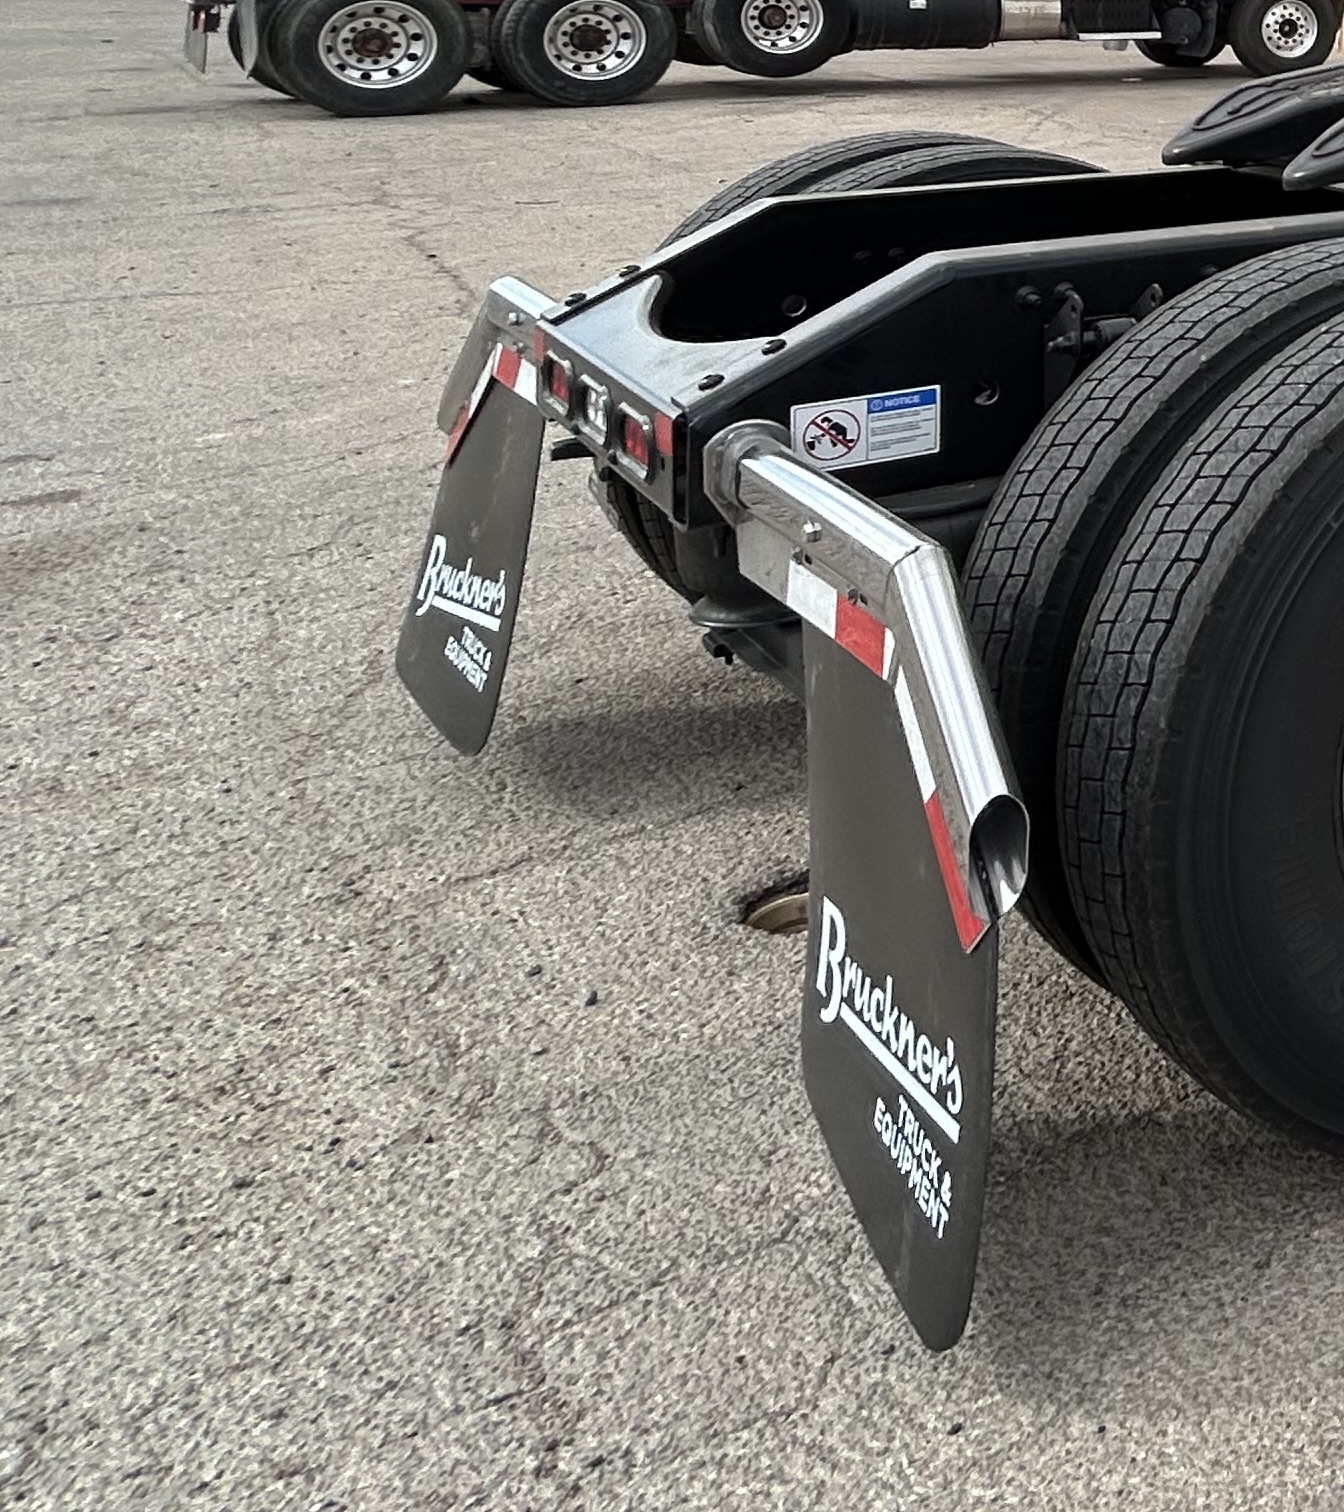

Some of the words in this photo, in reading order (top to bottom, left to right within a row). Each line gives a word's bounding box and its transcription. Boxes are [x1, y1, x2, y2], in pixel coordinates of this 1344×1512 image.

[884, 394, 921, 408] NOTICE
[414, 533, 507, 617] Bruckner's
[444, 635, 488, 693] EQUIPMENT
[460, 625, 488, 666] TRUCK
[816, 895, 964, 1116] Bruckner's
[873, 1096, 950, 1240] EQUIPMENT
[898, 1094, 942, 1189] TRUCK
[941, 1170, 952, 1208] &
